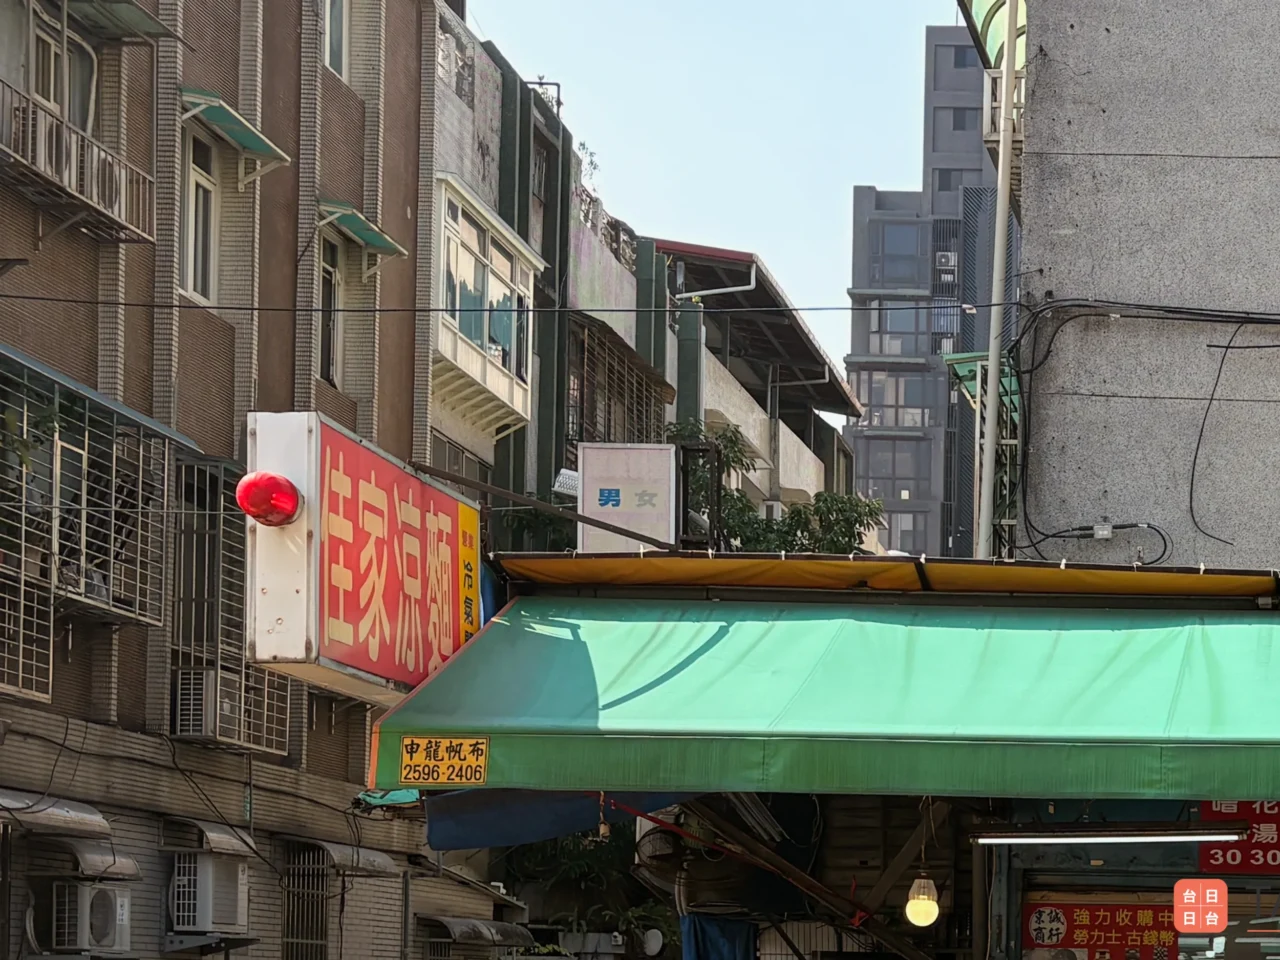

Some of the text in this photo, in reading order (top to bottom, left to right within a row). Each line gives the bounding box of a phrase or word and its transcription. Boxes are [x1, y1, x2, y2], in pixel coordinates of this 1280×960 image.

[598, 488, 657, 508] 男 女
[320, 445, 454, 676] 佳家涼麵
[403, 738, 485, 762] 申龍帆布
[402, 764, 484, 782] 2596-2406
[1209, 849, 1243, 866] 30
